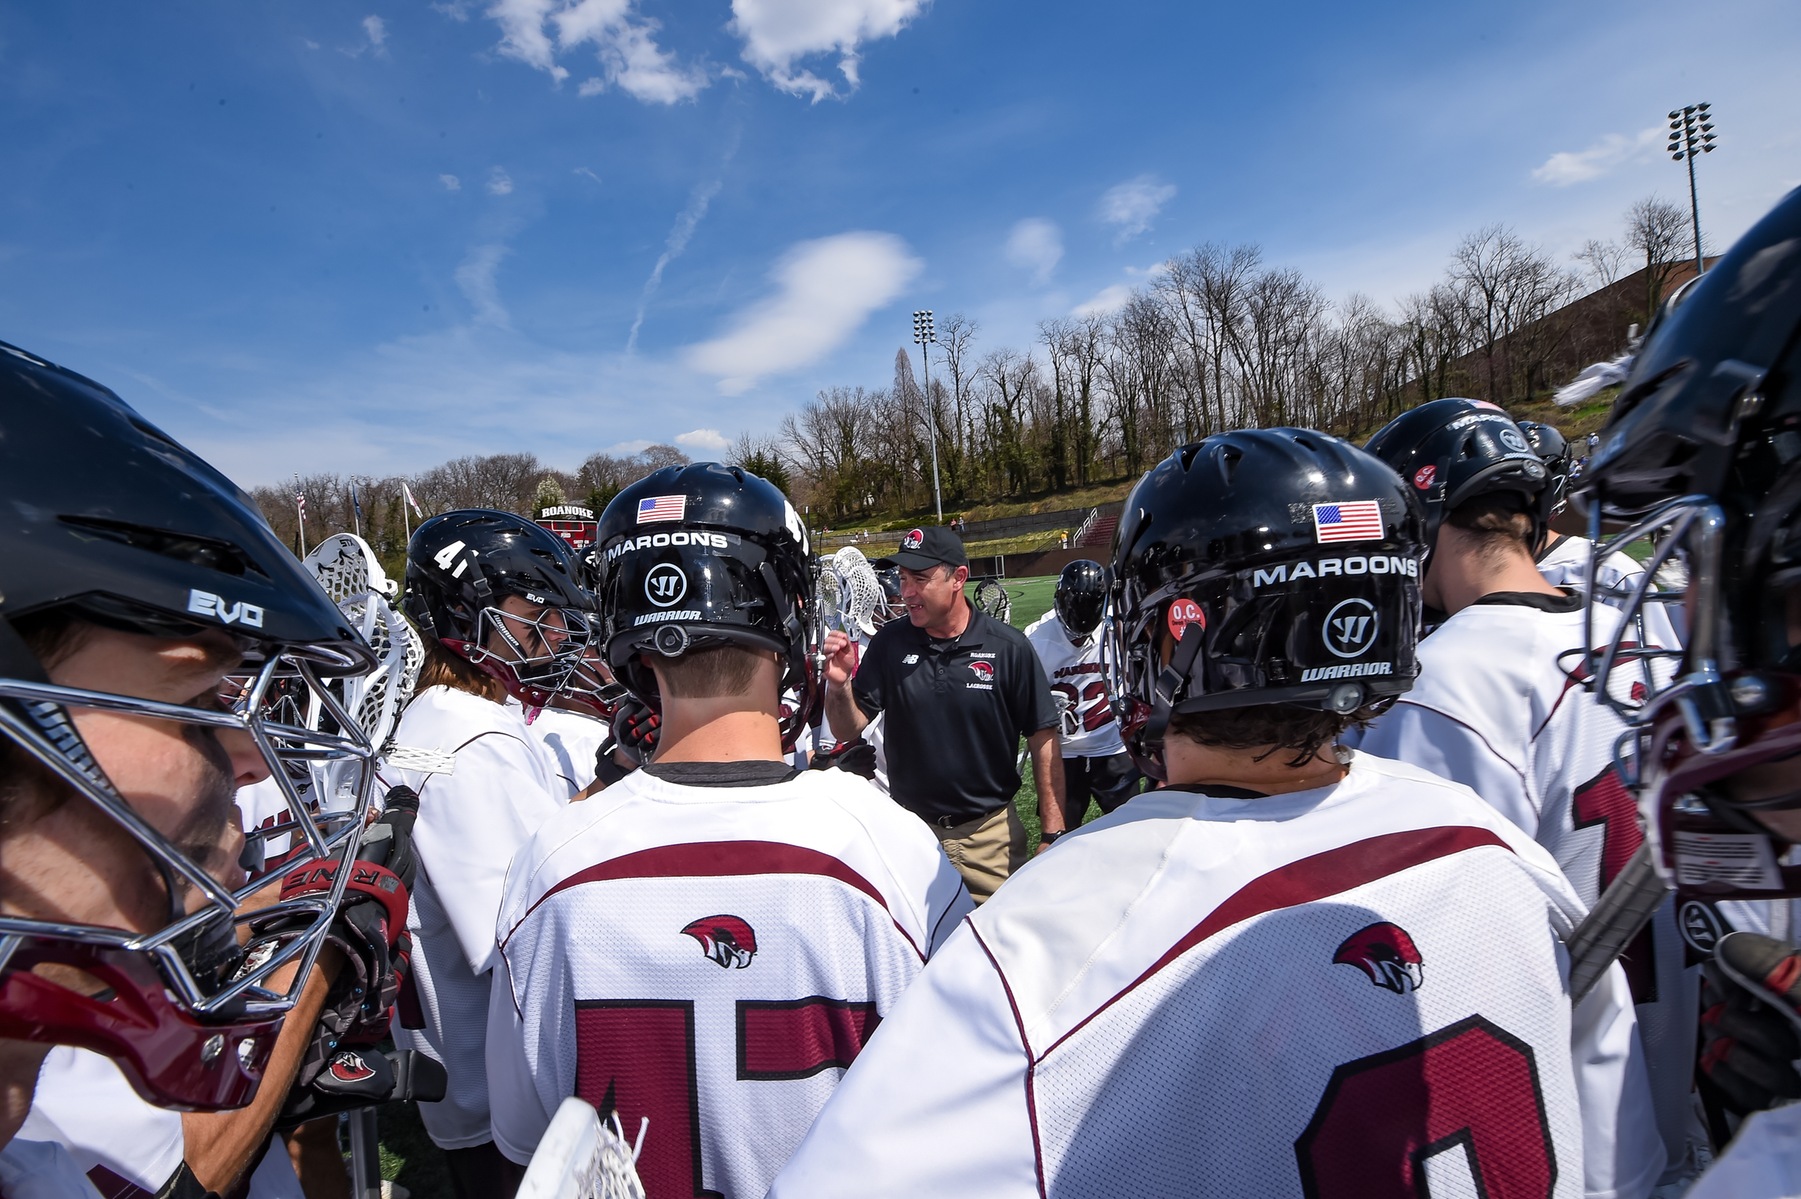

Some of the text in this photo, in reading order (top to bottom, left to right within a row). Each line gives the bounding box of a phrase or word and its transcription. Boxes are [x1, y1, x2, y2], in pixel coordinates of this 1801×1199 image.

[541, 505, 594, 519] ROANOKE
[608, 532, 728, 562] MAROONS
[1253, 556, 1418, 588] MAROONS
[526, 593, 545, 604] EVO
[188, 589, 264, 628] EVO
[1173, 604, 1201, 620] O.C.
[966, 682, 993, 690] LACROSSE
